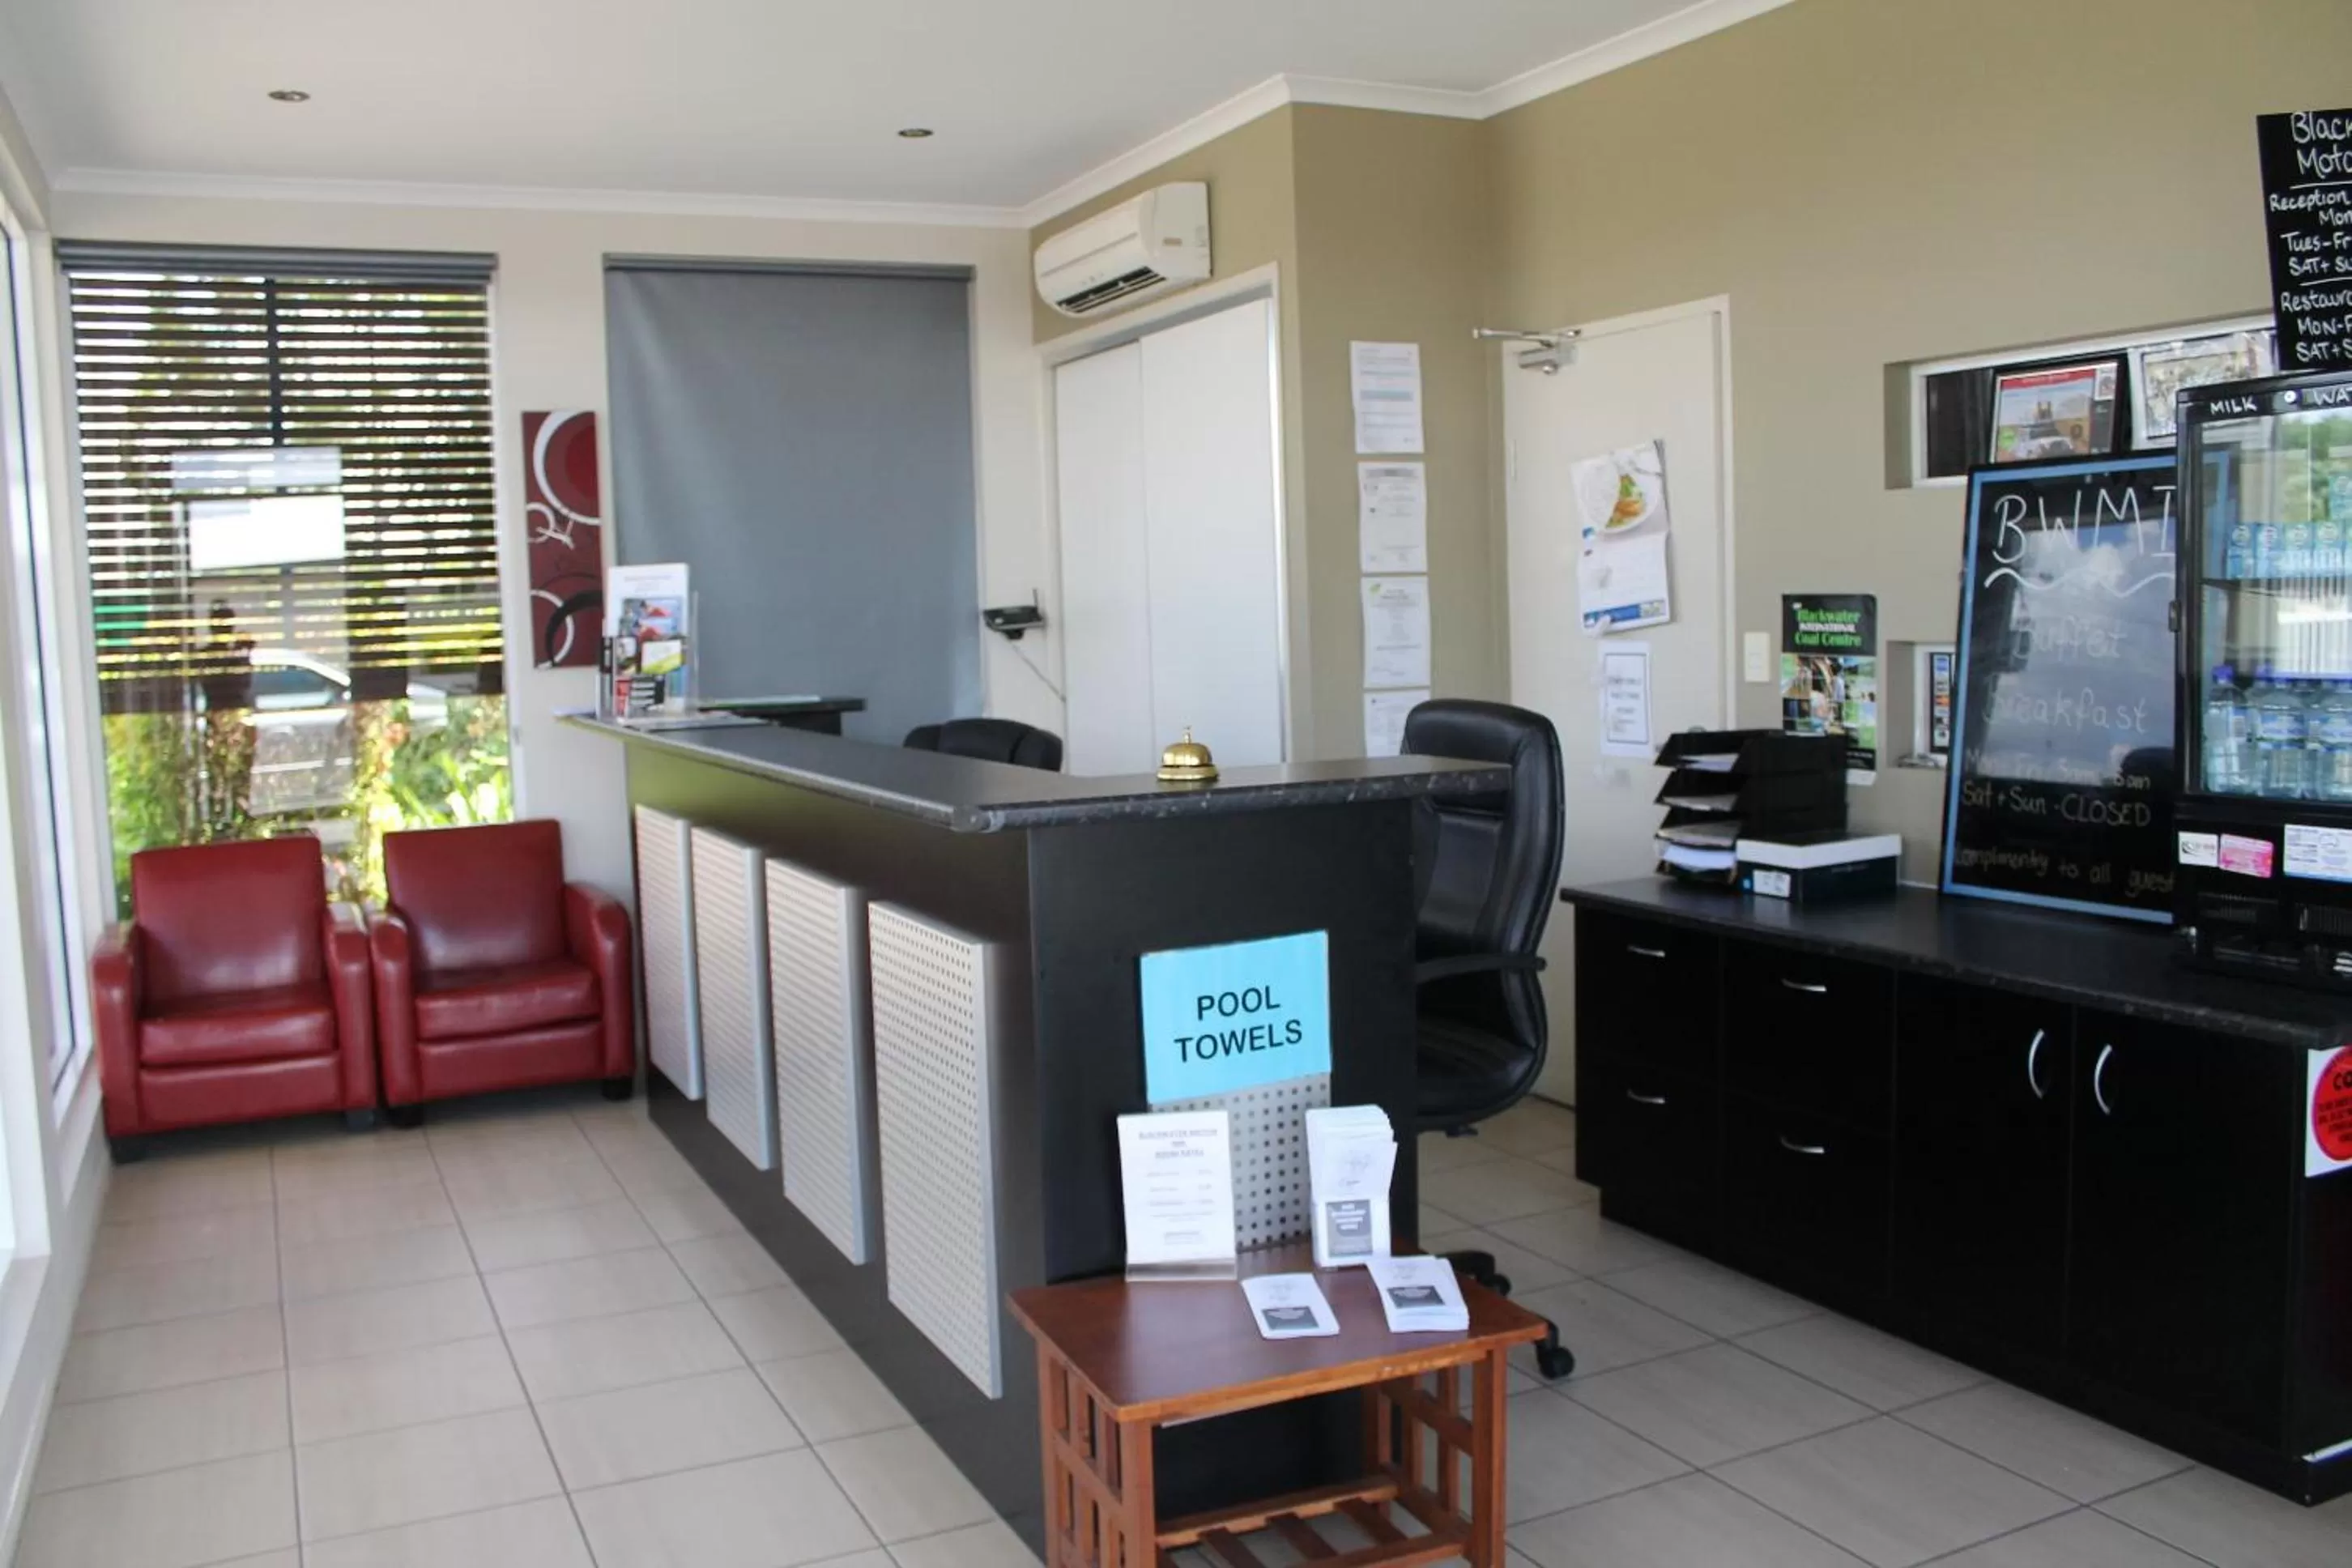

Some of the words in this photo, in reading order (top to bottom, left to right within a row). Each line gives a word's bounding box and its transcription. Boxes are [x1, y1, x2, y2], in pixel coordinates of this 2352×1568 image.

[2269, 189, 2351, 212] Reception
[2318, 208, 2352, 226] Mon
[2210, 395, 2258, 415] MILK
[1962, 781, 1992, 808] Sat
[2009, 786, 2047, 814] Sun
[2090, 863, 2111, 884] all
[1197, 985, 1281, 1021] POOL
[1174, 1019, 1302, 1063] TOWELS
